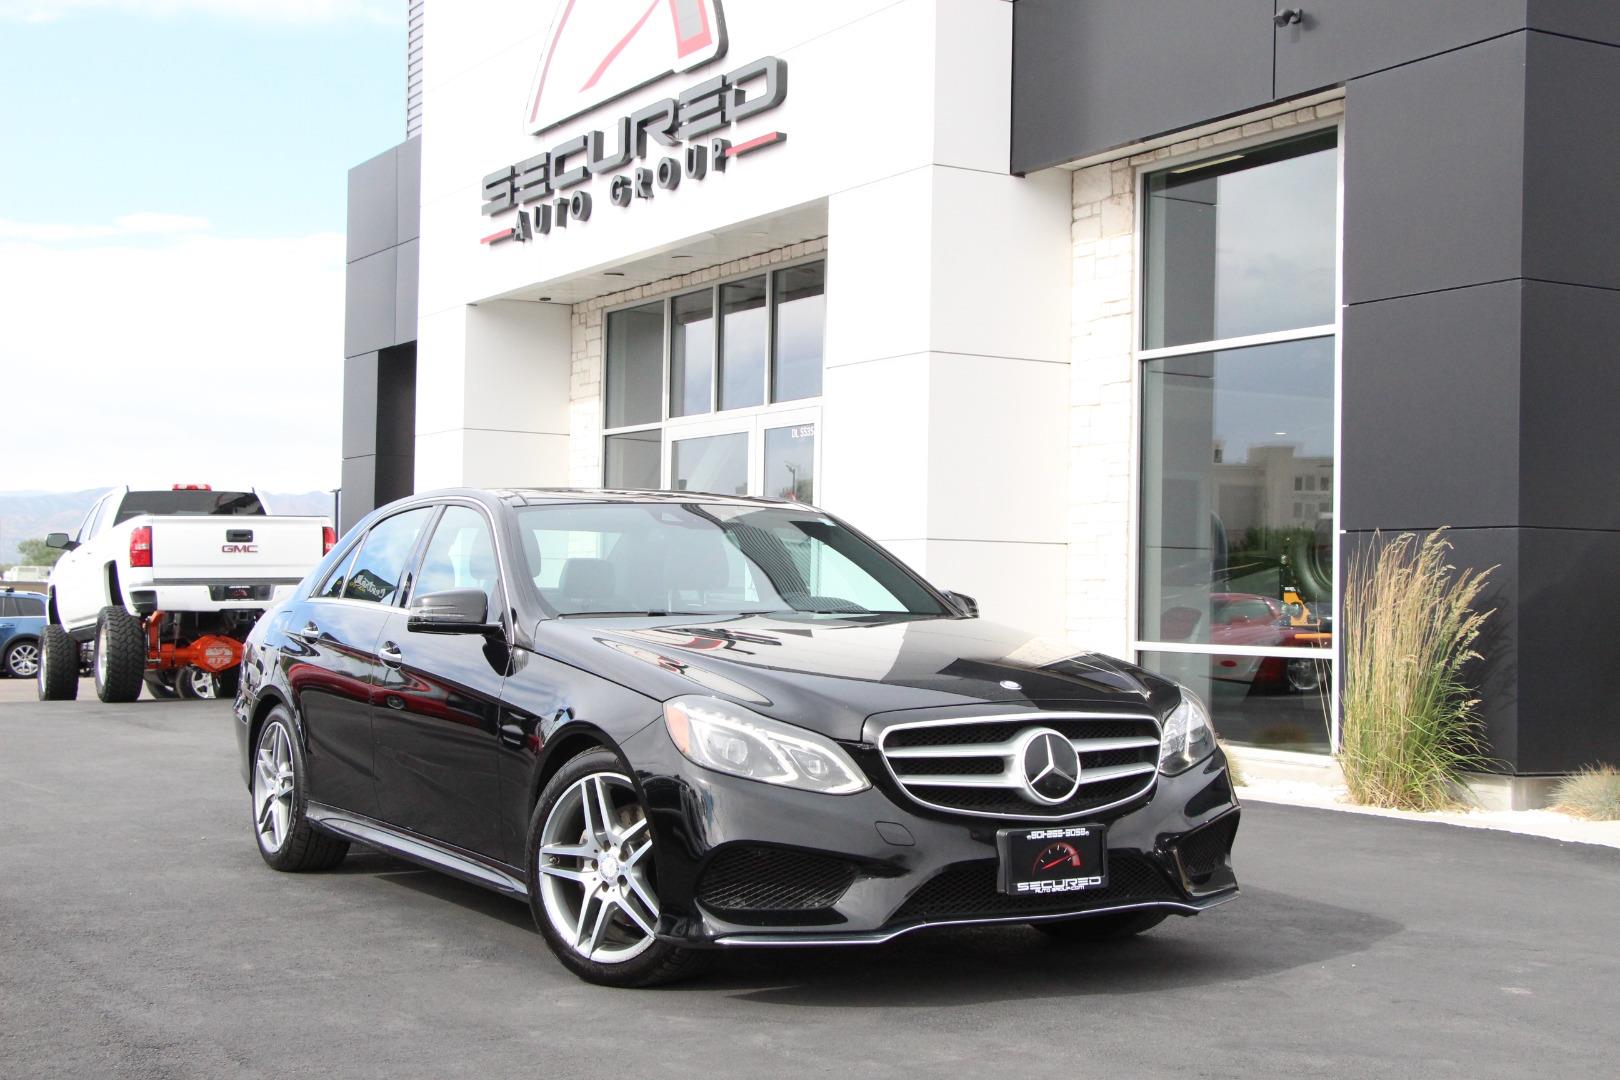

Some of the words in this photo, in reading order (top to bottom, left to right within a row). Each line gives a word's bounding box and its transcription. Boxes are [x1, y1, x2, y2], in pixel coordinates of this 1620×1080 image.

[482, 55, 788, 216] SECURED
[513, 190, 592, 243] AUTO
[609, 137, 732, 208] GROUP
[222, 544, 259, 553] GMC
[1017, 876, 1102, 892] SECURED
